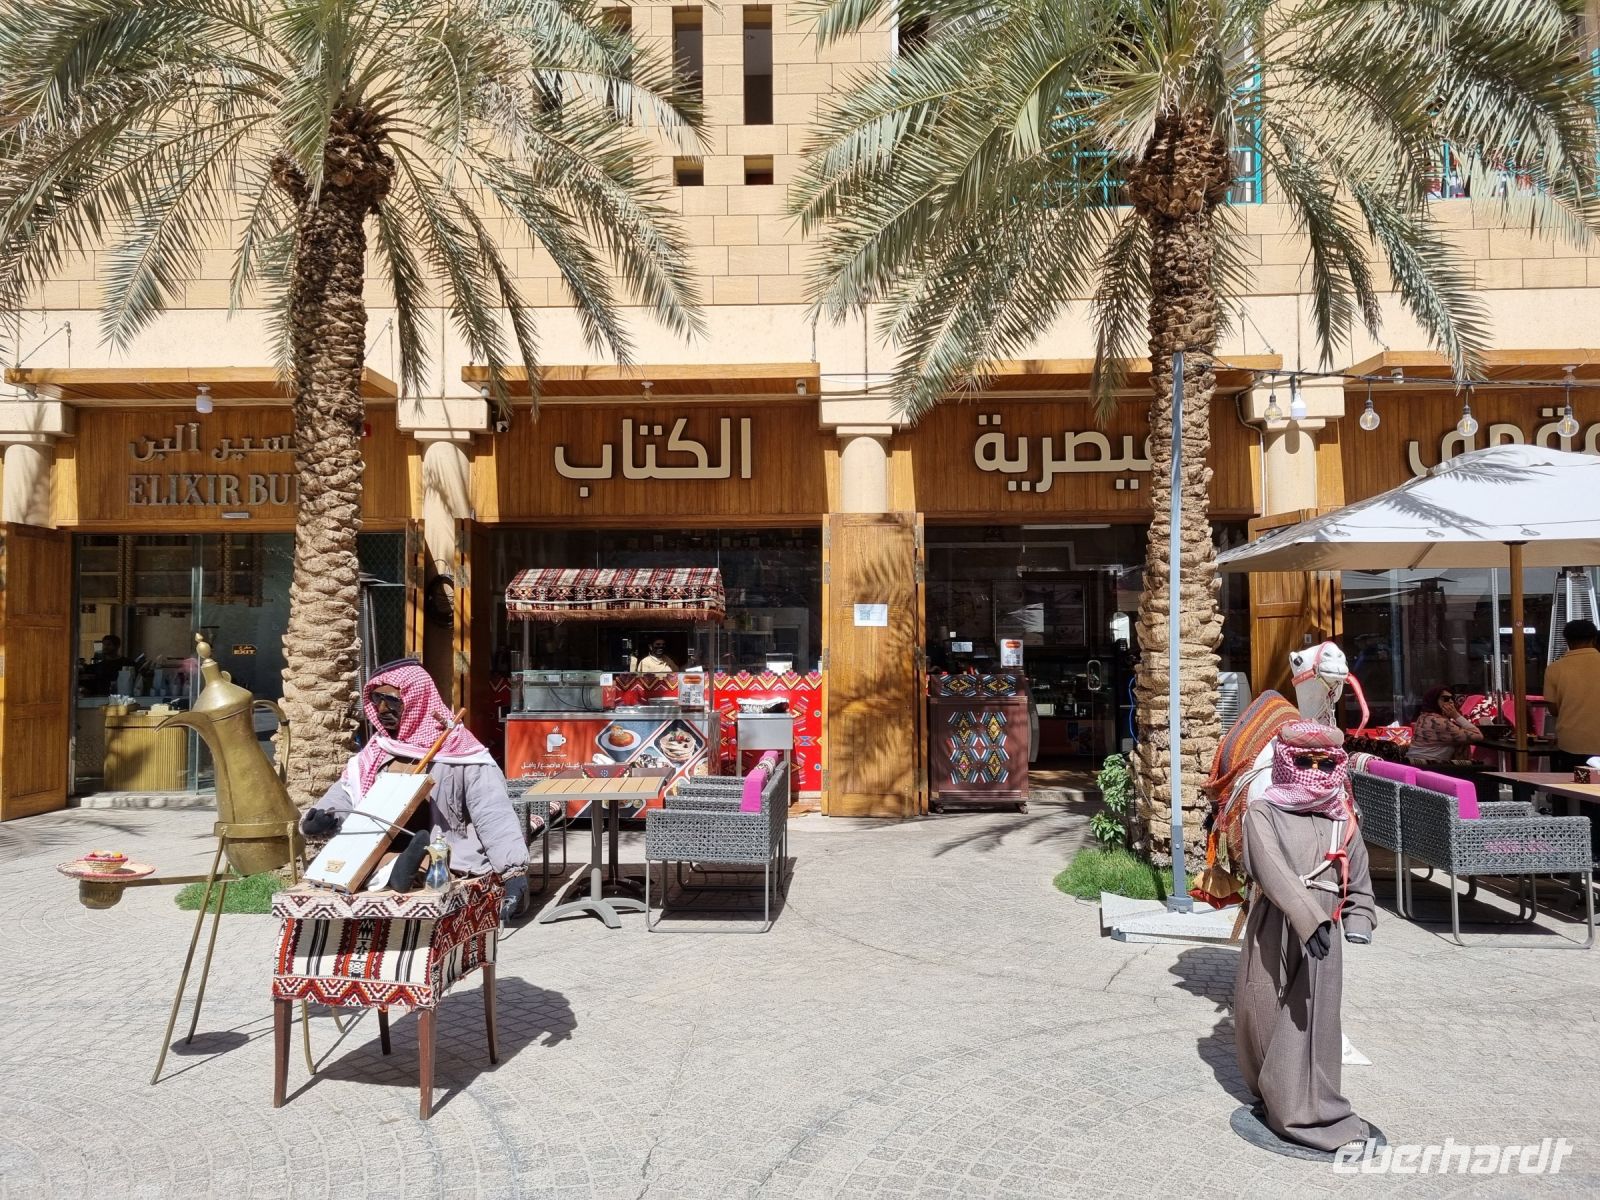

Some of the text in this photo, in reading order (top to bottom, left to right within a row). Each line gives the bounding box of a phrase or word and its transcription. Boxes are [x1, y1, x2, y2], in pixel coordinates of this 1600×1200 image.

[128, 422, 200, 462] البن
[553, 417, 753, 498] الكتاب
[974, 414, 1152, 493] يصرية
[128, 474, 240, 506] ELIXIR
